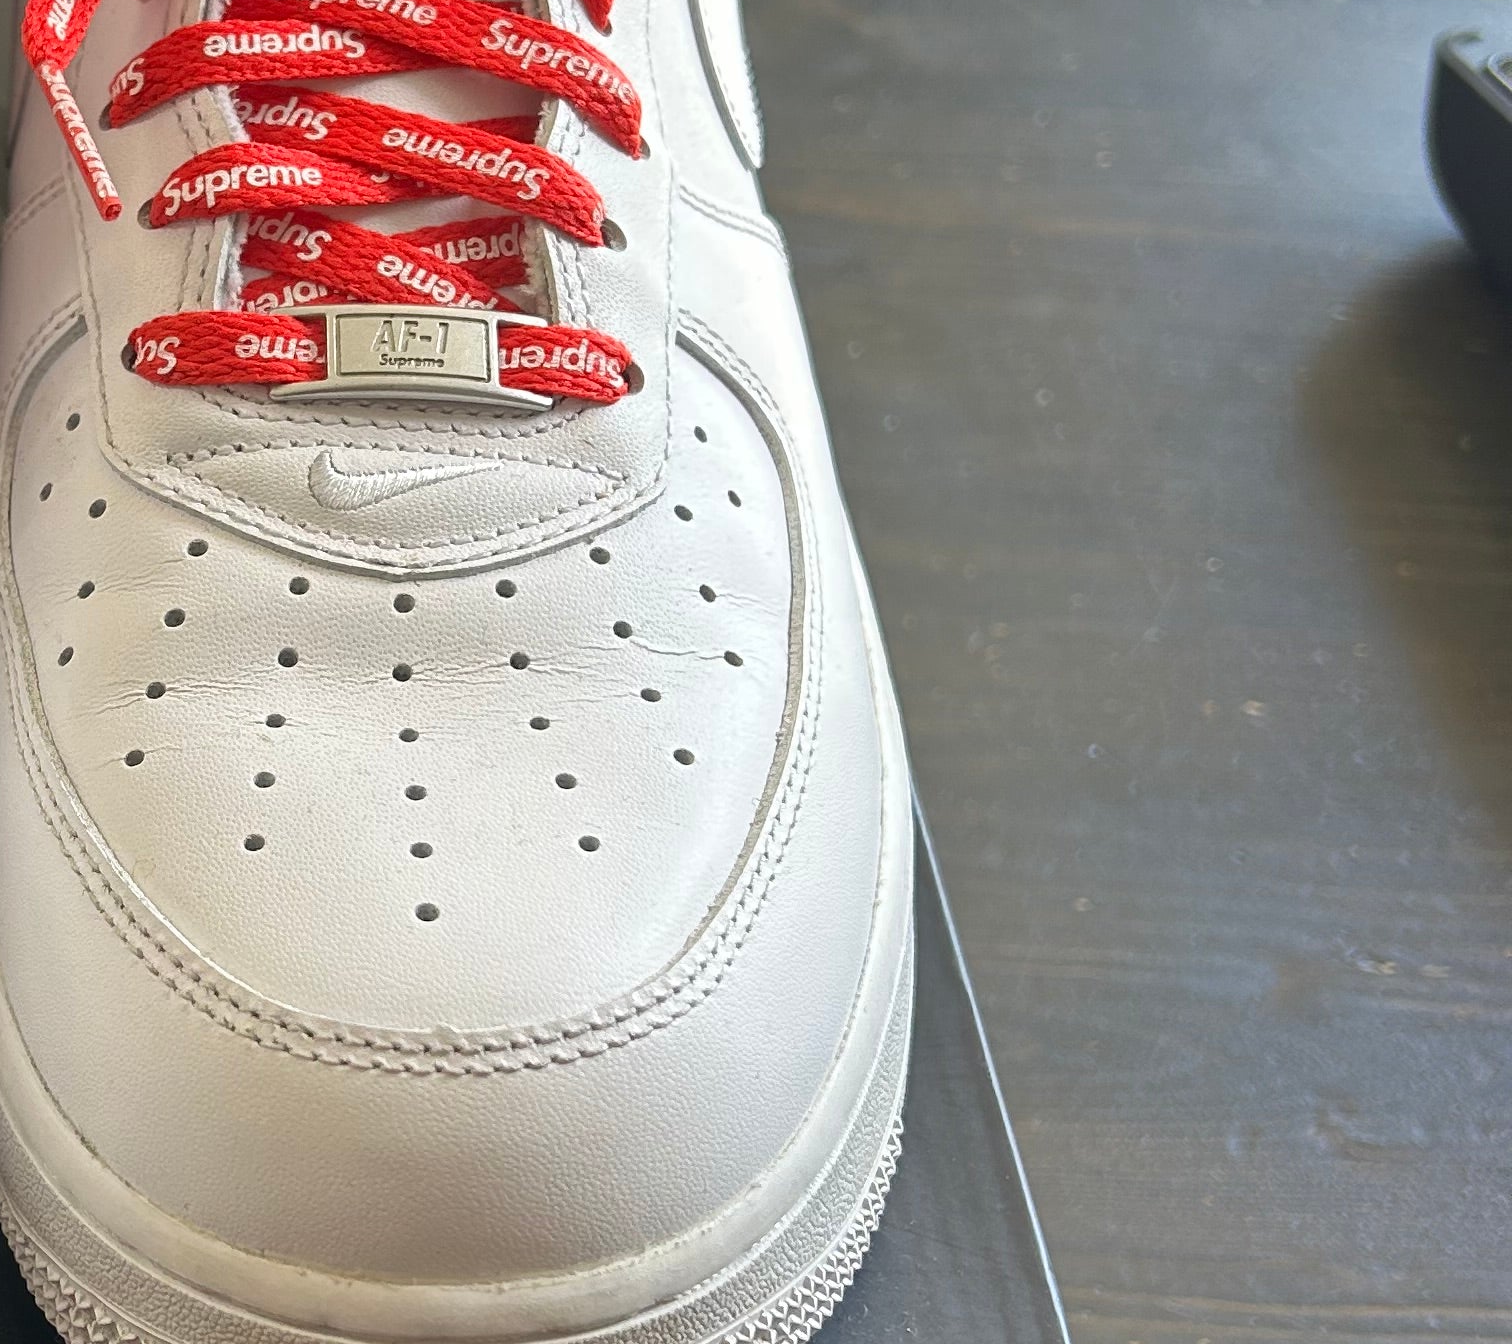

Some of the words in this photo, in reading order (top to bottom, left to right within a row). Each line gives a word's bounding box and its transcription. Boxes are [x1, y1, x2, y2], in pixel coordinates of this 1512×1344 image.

[203, 24, 367, 58] Supreme
[481, 19, 636, 106] Supreme
[162, 163, 324, 217] Supreme
[382, 127, 551, 201] Supreme
[379, 353, 446, 370] Supreme
